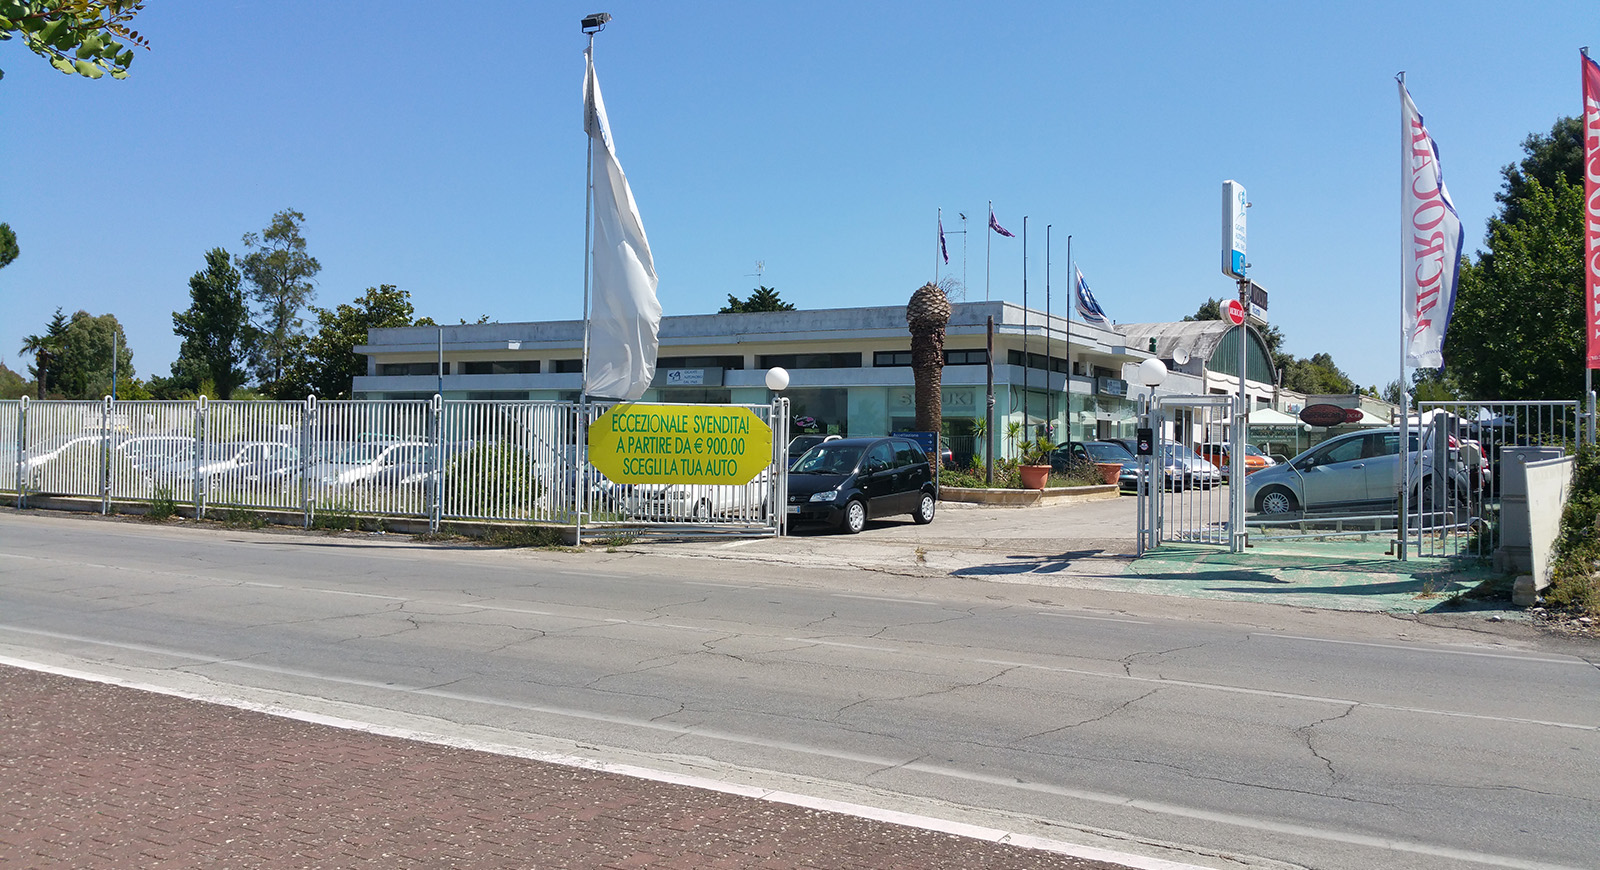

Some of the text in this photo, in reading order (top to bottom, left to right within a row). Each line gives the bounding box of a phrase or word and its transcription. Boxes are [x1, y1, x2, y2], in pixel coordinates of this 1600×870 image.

[901, 391, 975, 406] SUKI
[612, 413, 749, 435] ECCEZIONALE SVENDITA!
[616, 436, 745, 455] A PARTIRE DA € 900,00
[623, 458, 737, 476] SCEGLI LA TUA AUTO
